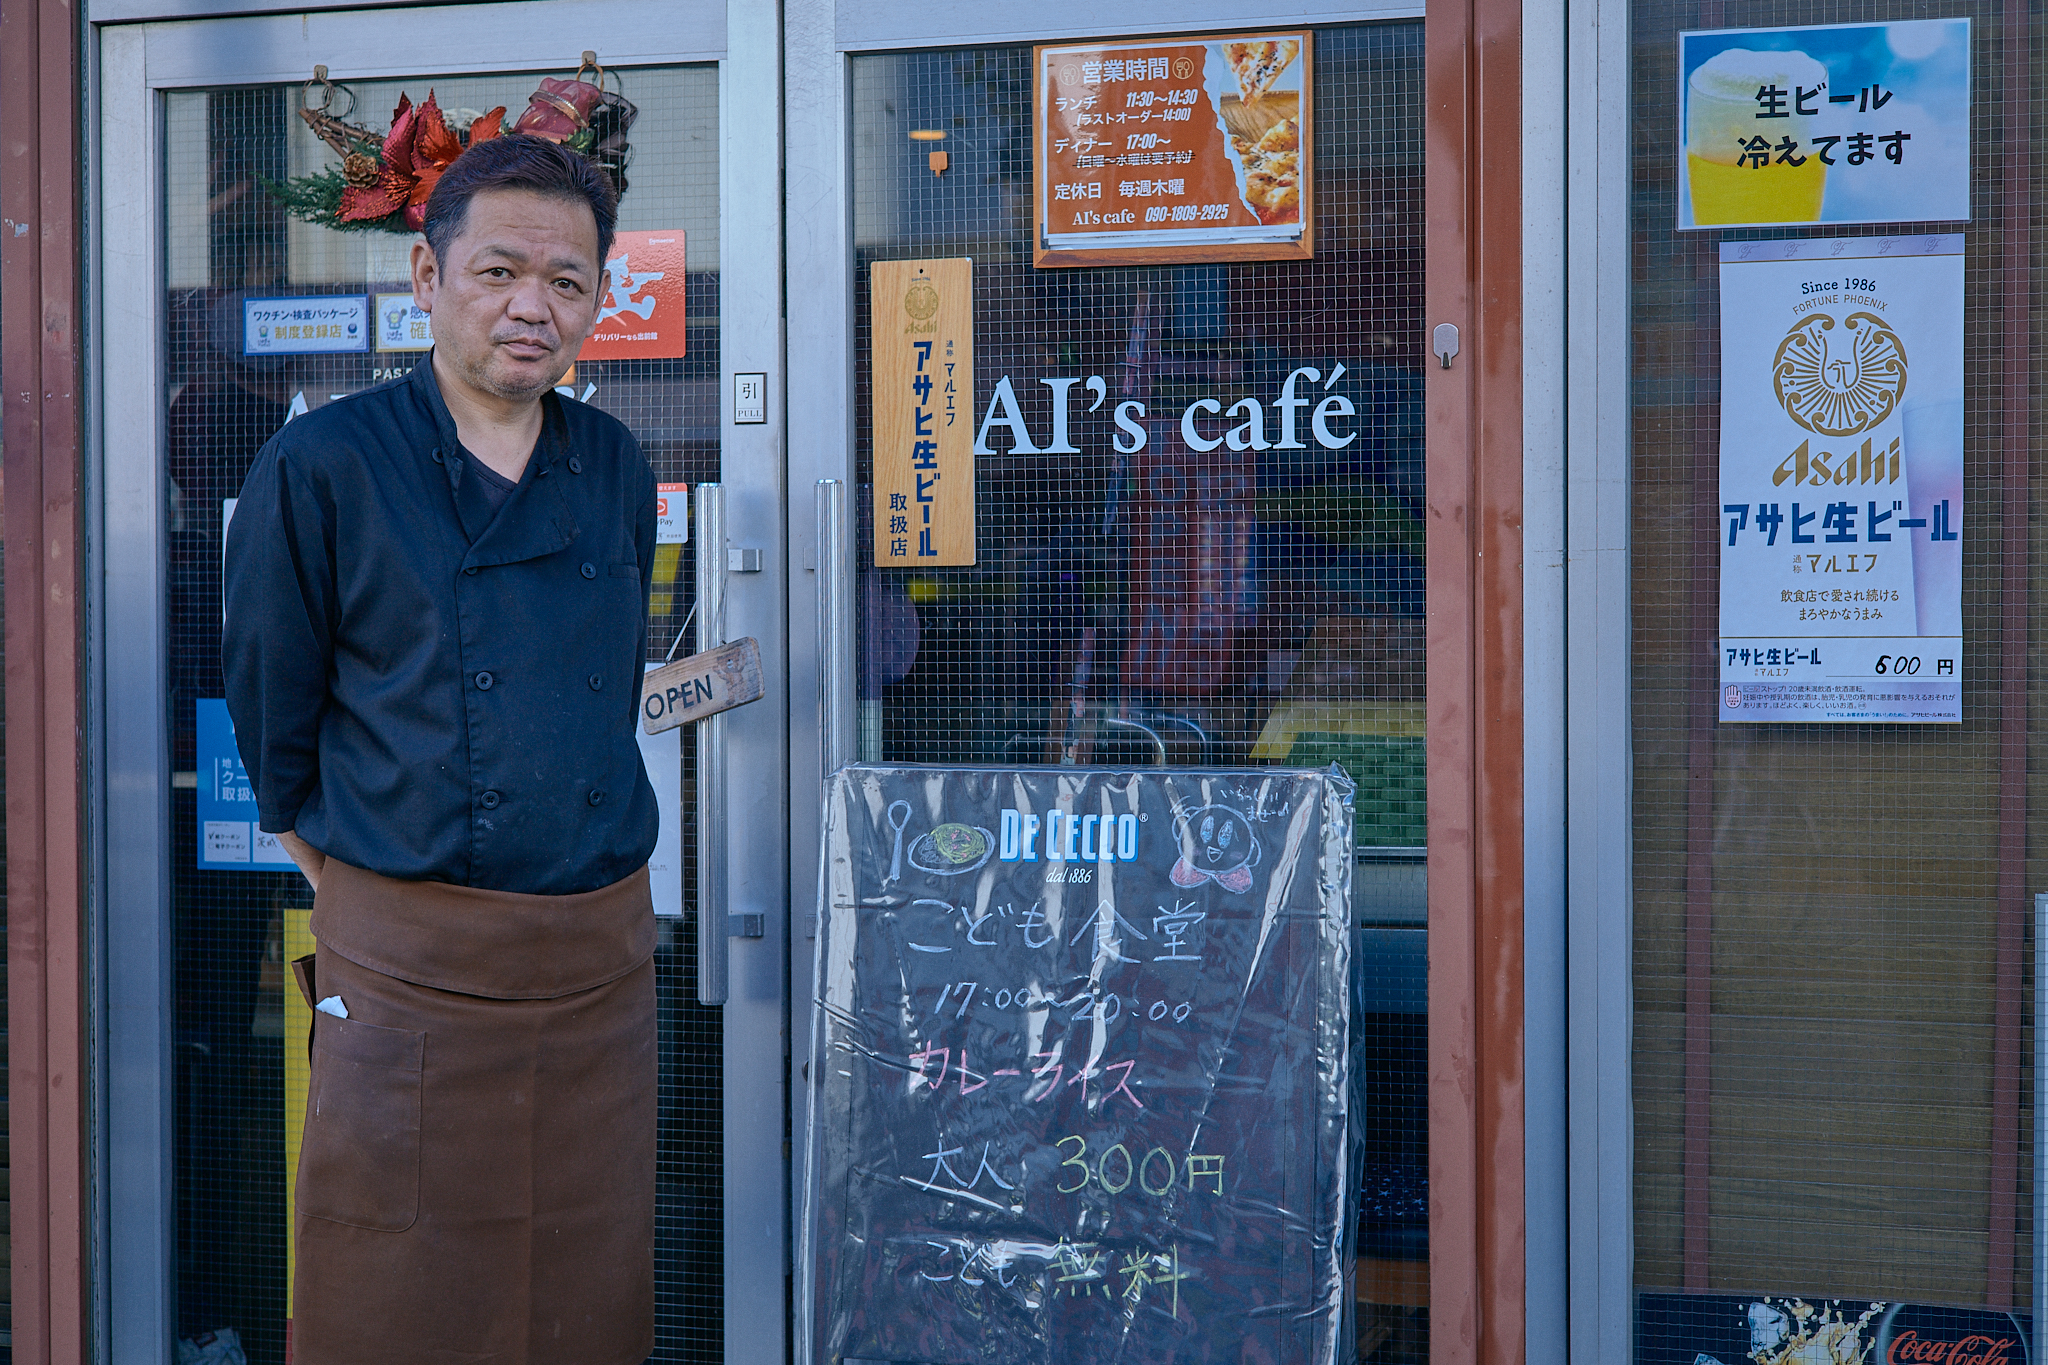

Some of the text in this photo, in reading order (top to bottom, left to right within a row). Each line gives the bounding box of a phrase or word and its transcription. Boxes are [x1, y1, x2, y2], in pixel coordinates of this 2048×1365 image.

[1081, 56, 1169, 85] 営業時間
[1055, 88, 1198, 112] ランチ 11:30〜14:30
[1754, 82, 1893, 119] 生ビール
[1054, 137, 1113, 154] ディナー
[1736, 130, 1911, 170] 冷えてます
[1054, 178, 1185, 201] 定休日 毎週木曜
[1072, 204, 1229, 226] AI's cafe 090-1809-2925
[1801, 278, 1877, 295] Since 1986
[253, 307, 359, 322] ワクチン・検査パッケージ
[1792, 294, 1888, 316] FORTUNE PHOENIX
[274, 324, 343, 340] 制度登録店
[410, 320, 434, 340] 確
[904, 320, 938, 334] Asahi
[742, 382, 757, 399] 引
[944, 362, 957, 427] マルエフ
[737, 409, 762, 418] PULL
[973, 361, 1358, 456] AI's café
[912, 341, 941, 556] アサヒ生ビール
[1772, 436, 1900, 487] Asahi
[889, 492, 908, 557] 取扱店
[1723, 499, 1958, 547] アサヒ生ビール
[1806, 554, 1878, 573] マルエフ
[1780, 588, 1900, 603] 飲食店で愛され続ける
[1799, 607, 1883, 621] まろやかなうまみ
[1726, 647, 1822, 667] アサヒ生ビール
[1875, 655, 1954, 675] 600 円
[645, 674, 713, 720] OPEN
[222, 786, 257, 802] 取扱
[999, 808, 1040, 863] DE
[1046, 867, 1092, 884] dal 1886
[908, 898, 1206, 965] こども食堂
[908, 1039, 1144, 1109] カレーライス
[922, 1132, 1224, 1198] 大人 300円
[1045, 1235, 1191, 1321] 無料
